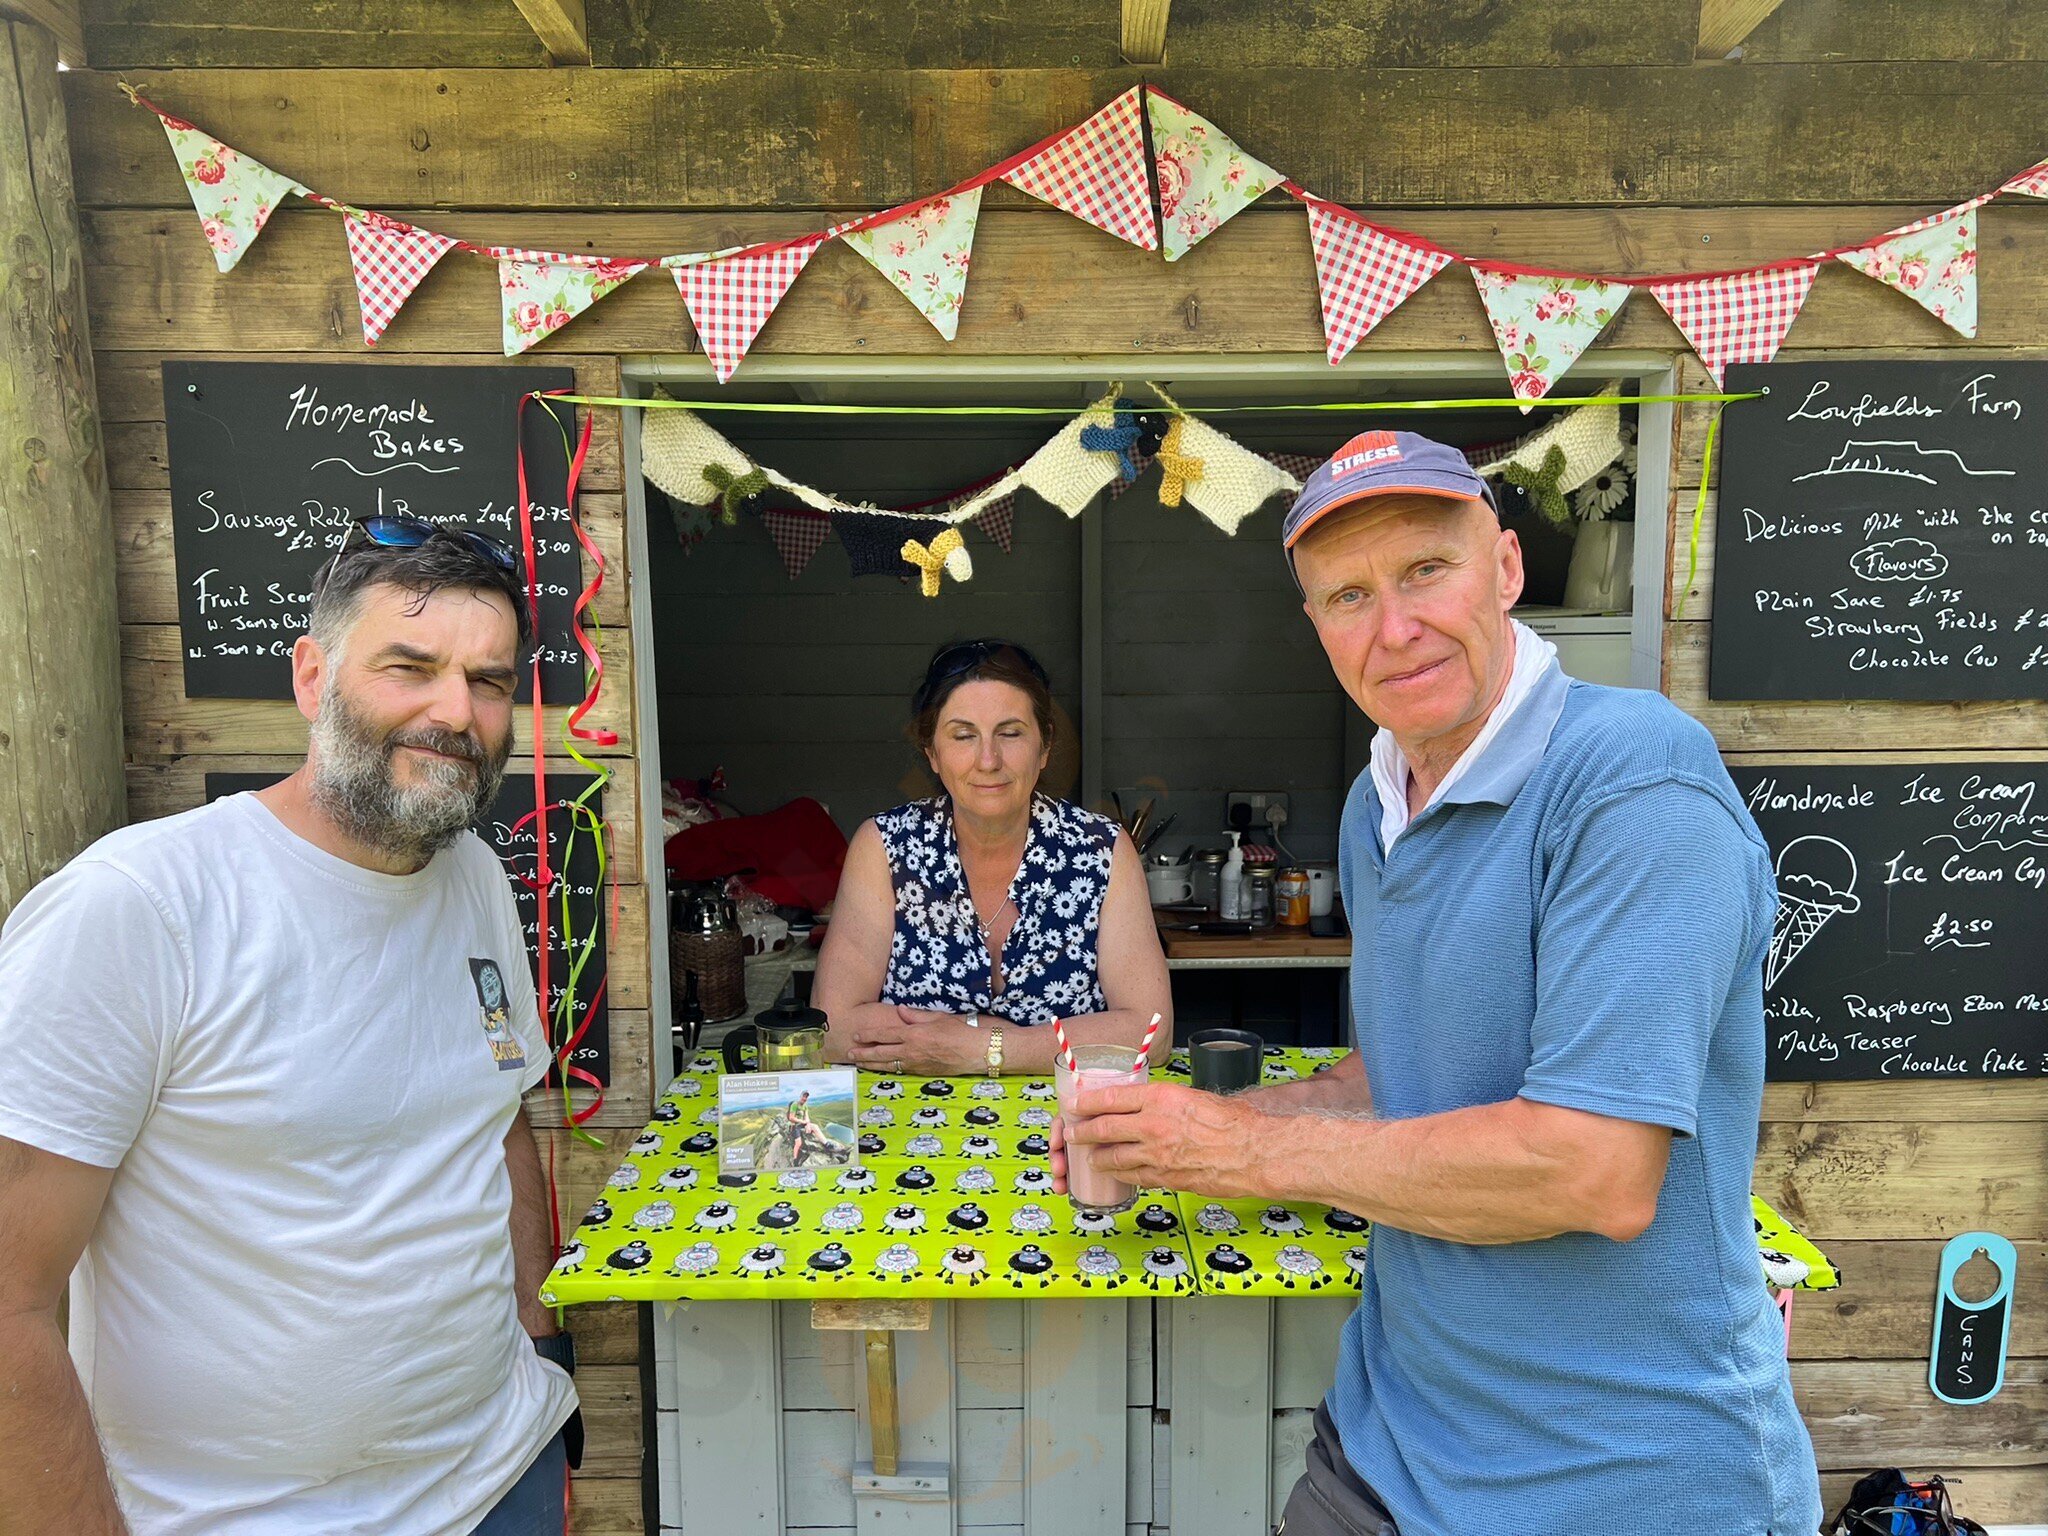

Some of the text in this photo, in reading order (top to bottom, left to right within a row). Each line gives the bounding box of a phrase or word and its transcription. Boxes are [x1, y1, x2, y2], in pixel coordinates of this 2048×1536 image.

[285, 384, 434, 432] Homemade
[1787, 374, 2021, 426] Lowfields Farm
[369, 431, 464, 458] Bakes
[1332, 445, 1400, 475] STRESS
[197, 491, 298, 537] Sausage
[476, 502, 515, 531] Loaf
[1742, 507, 1843, 542] Delicious
[1863, 512, 1903, 541] Milk
[1978, 506, 2014, 525] the
[287, 530, 343, 552] £2.50
[523, 536, 571, 556] 3.00
[1991, 532, 2013, 544] on
[1864, 552, 1937, 575] Flavours
[192, 569, 249, 614] Fruit
[1755, 585, 1963, 612] Plain Jane £1.75
[230, 616, 267, 630] Jam
[1804, 616, 1924, 643] Strawberry
[1935, 608, 1998, 632] Fields
[213, 643, 248, 655] Jam
[1849, 647, 1949, 671] Chocolate
[1963, 644, 1998, 667] Cow
[1749, 773, 2035, 815] Handmade Ice Cream
[493, 821, 557, 845] Drins
[1884, 850, 1927, 885] Ice
[1941, 854, 2003, 882] Cream
[1924, 912, 1993, 944] £2.50
[1843, 995, 1952, 1025] Raspberry
[1964, 995, 2004, 1012] Eton
[1778, 1030, 1917, 1061] Malty Teaser
[1881, 1053, 1968, 1074] Chocolate
